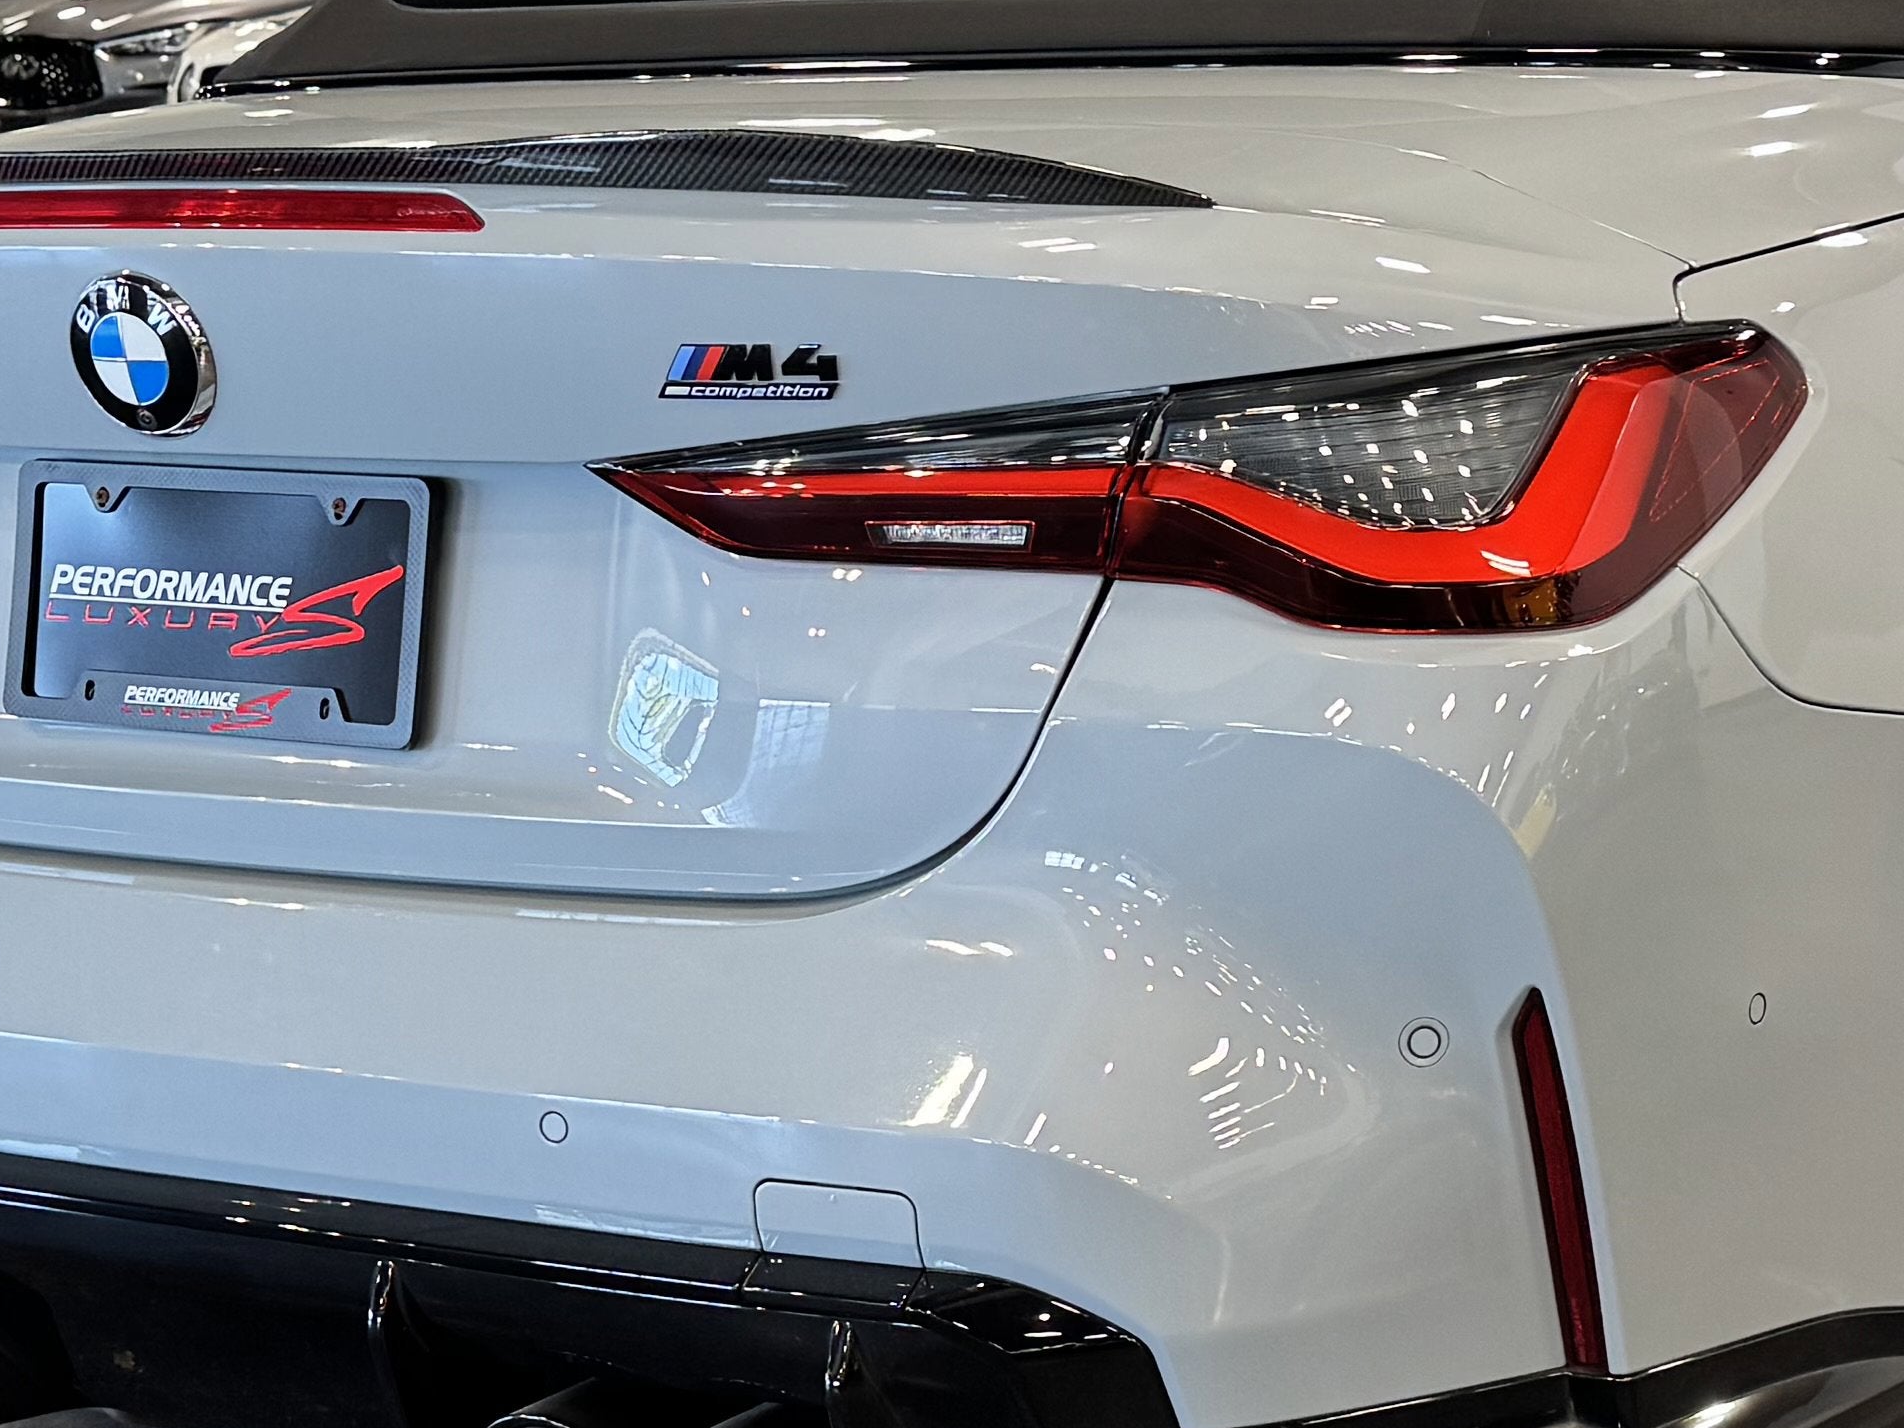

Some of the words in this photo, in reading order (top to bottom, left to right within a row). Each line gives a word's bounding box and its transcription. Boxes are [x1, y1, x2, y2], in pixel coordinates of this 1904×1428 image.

[76, 284, 177, 336] BMW
[690, 384, 829, 399] competition
[50, 563, 293, 609] PERFORMANCE
[45, 601, 280, 634] LUXURY
[124, 685, 241, 708] PERFORMANCE
